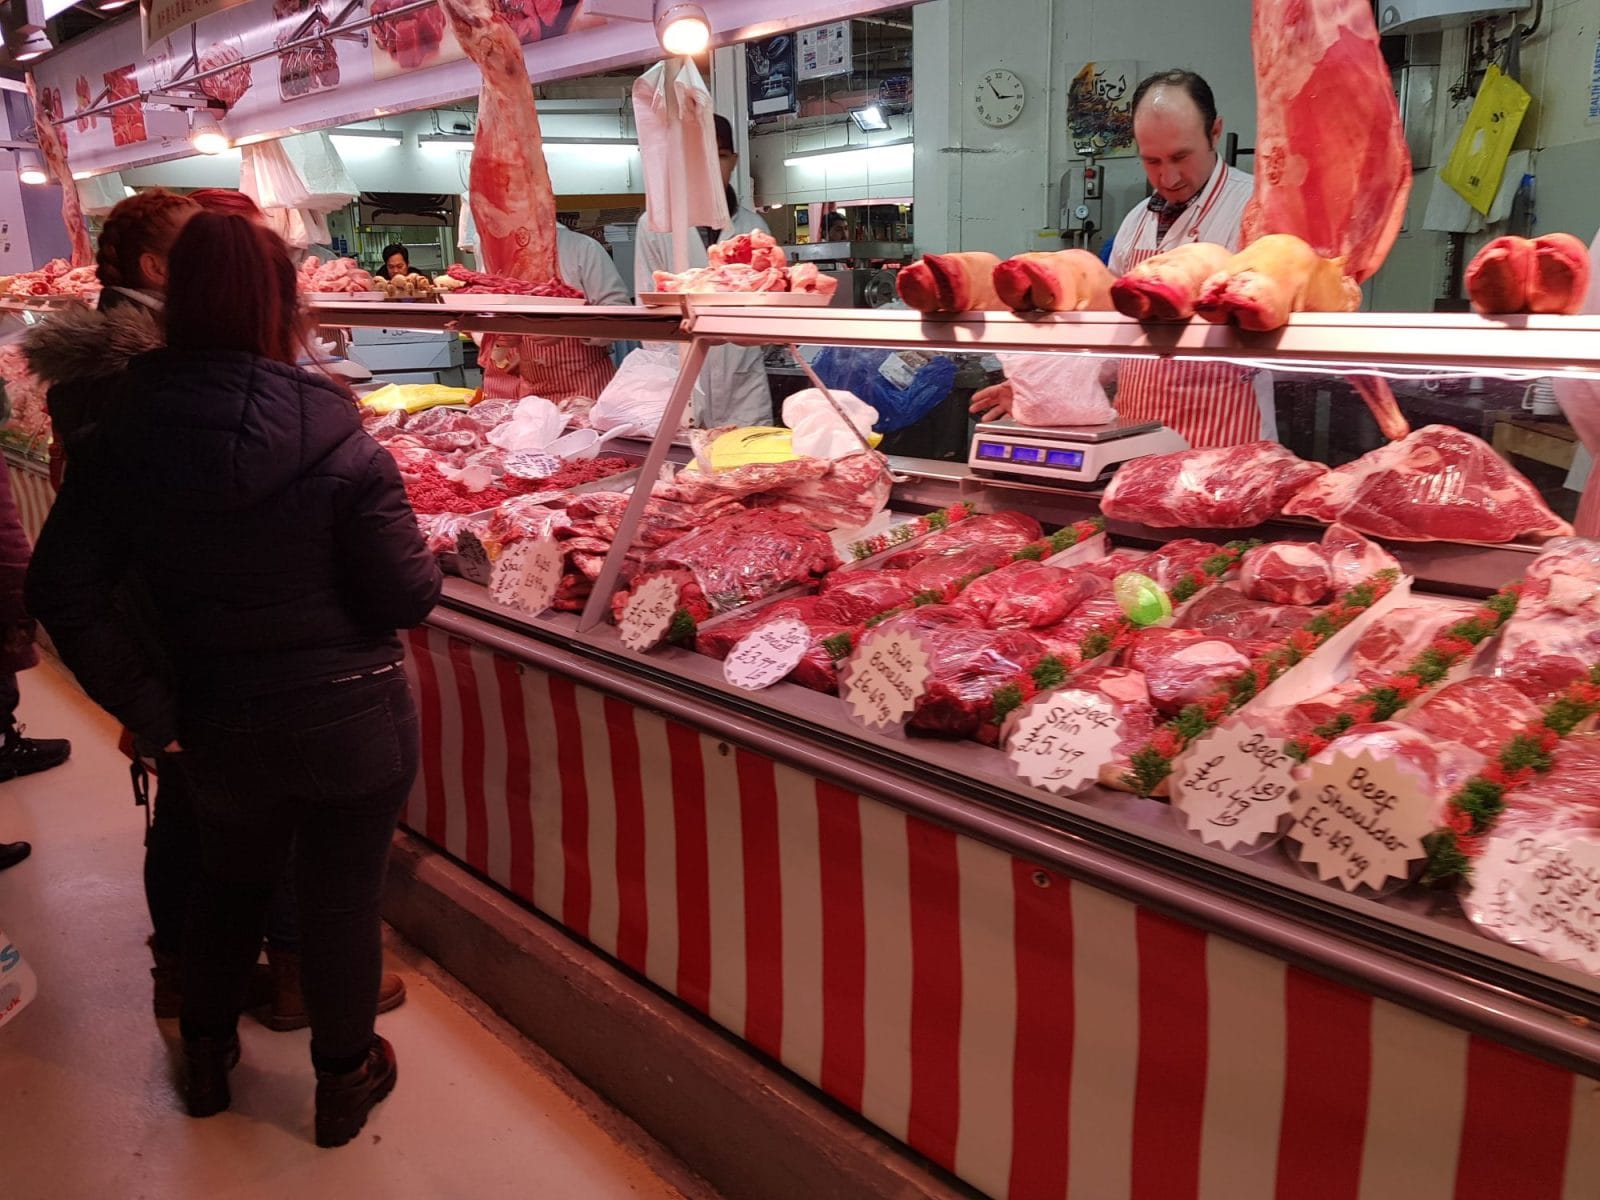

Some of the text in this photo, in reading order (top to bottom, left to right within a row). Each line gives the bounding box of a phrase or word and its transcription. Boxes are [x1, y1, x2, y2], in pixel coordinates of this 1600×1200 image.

[886, 641, 913, 673] Shin
[869, 651, 914, 701] Boneless
[1045, 706, 1082, 736] Shin
[1073, 704, 1118, 730] Beef
[1238, 732, 1288, 773] Beef
[1243, 774, 1287, 802] Leg
[1347, 766, 1399, 816] Beef
[1317, 783, 1410, 852] Shoulder
